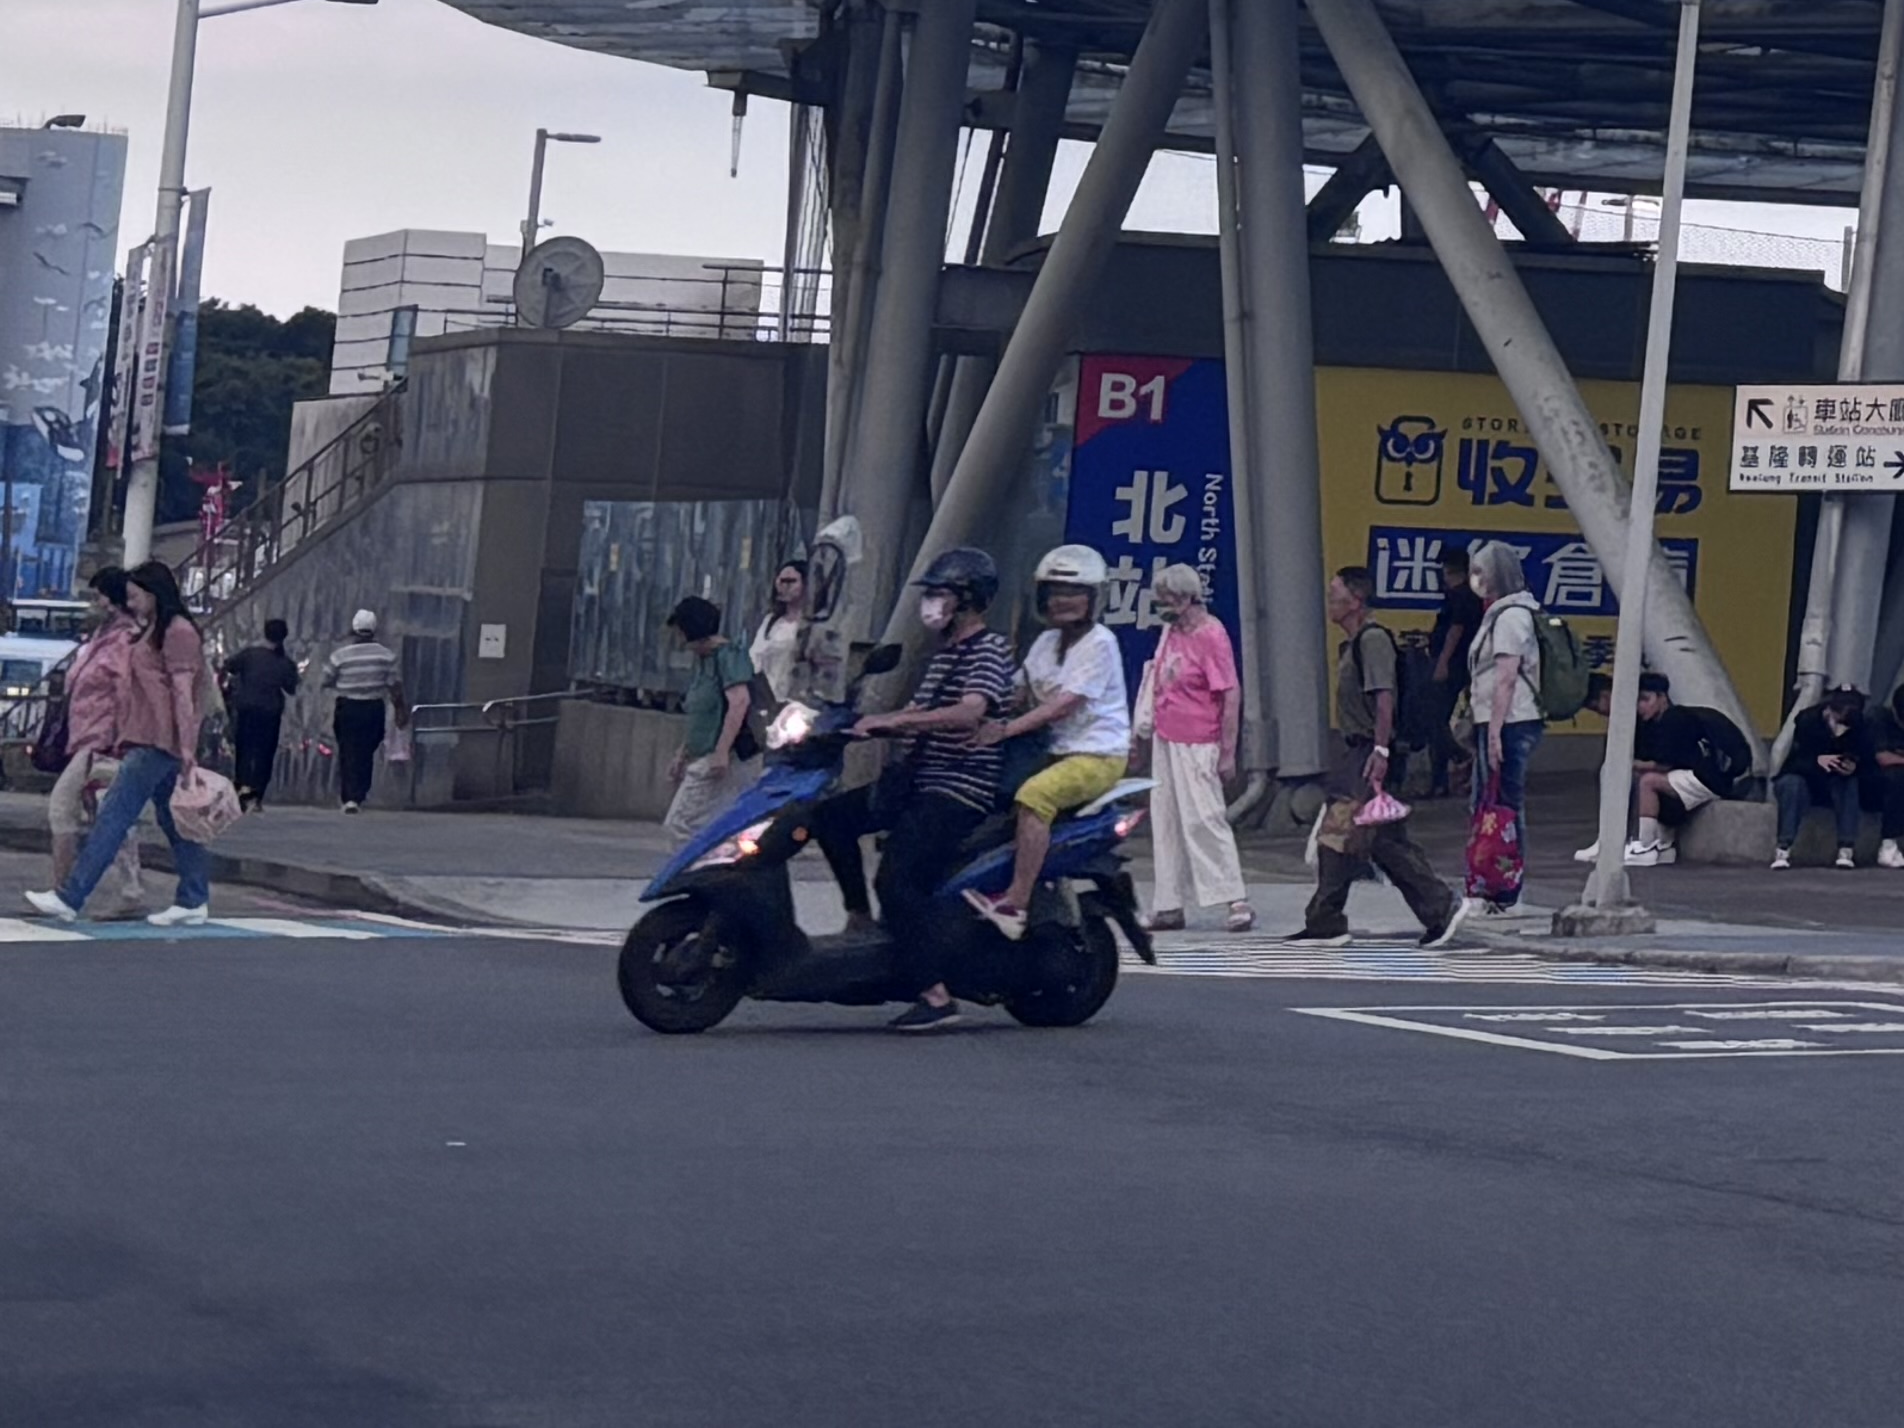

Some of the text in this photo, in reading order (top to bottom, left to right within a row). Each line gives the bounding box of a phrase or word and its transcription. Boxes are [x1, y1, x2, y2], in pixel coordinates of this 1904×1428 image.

[1098, 372, 1166, 423] B1
[1104, 470, 1188, 630] 北站
[1197, 473, 1224, 608] North Stati
[1376, 536, 1690, 608] 迷倉
